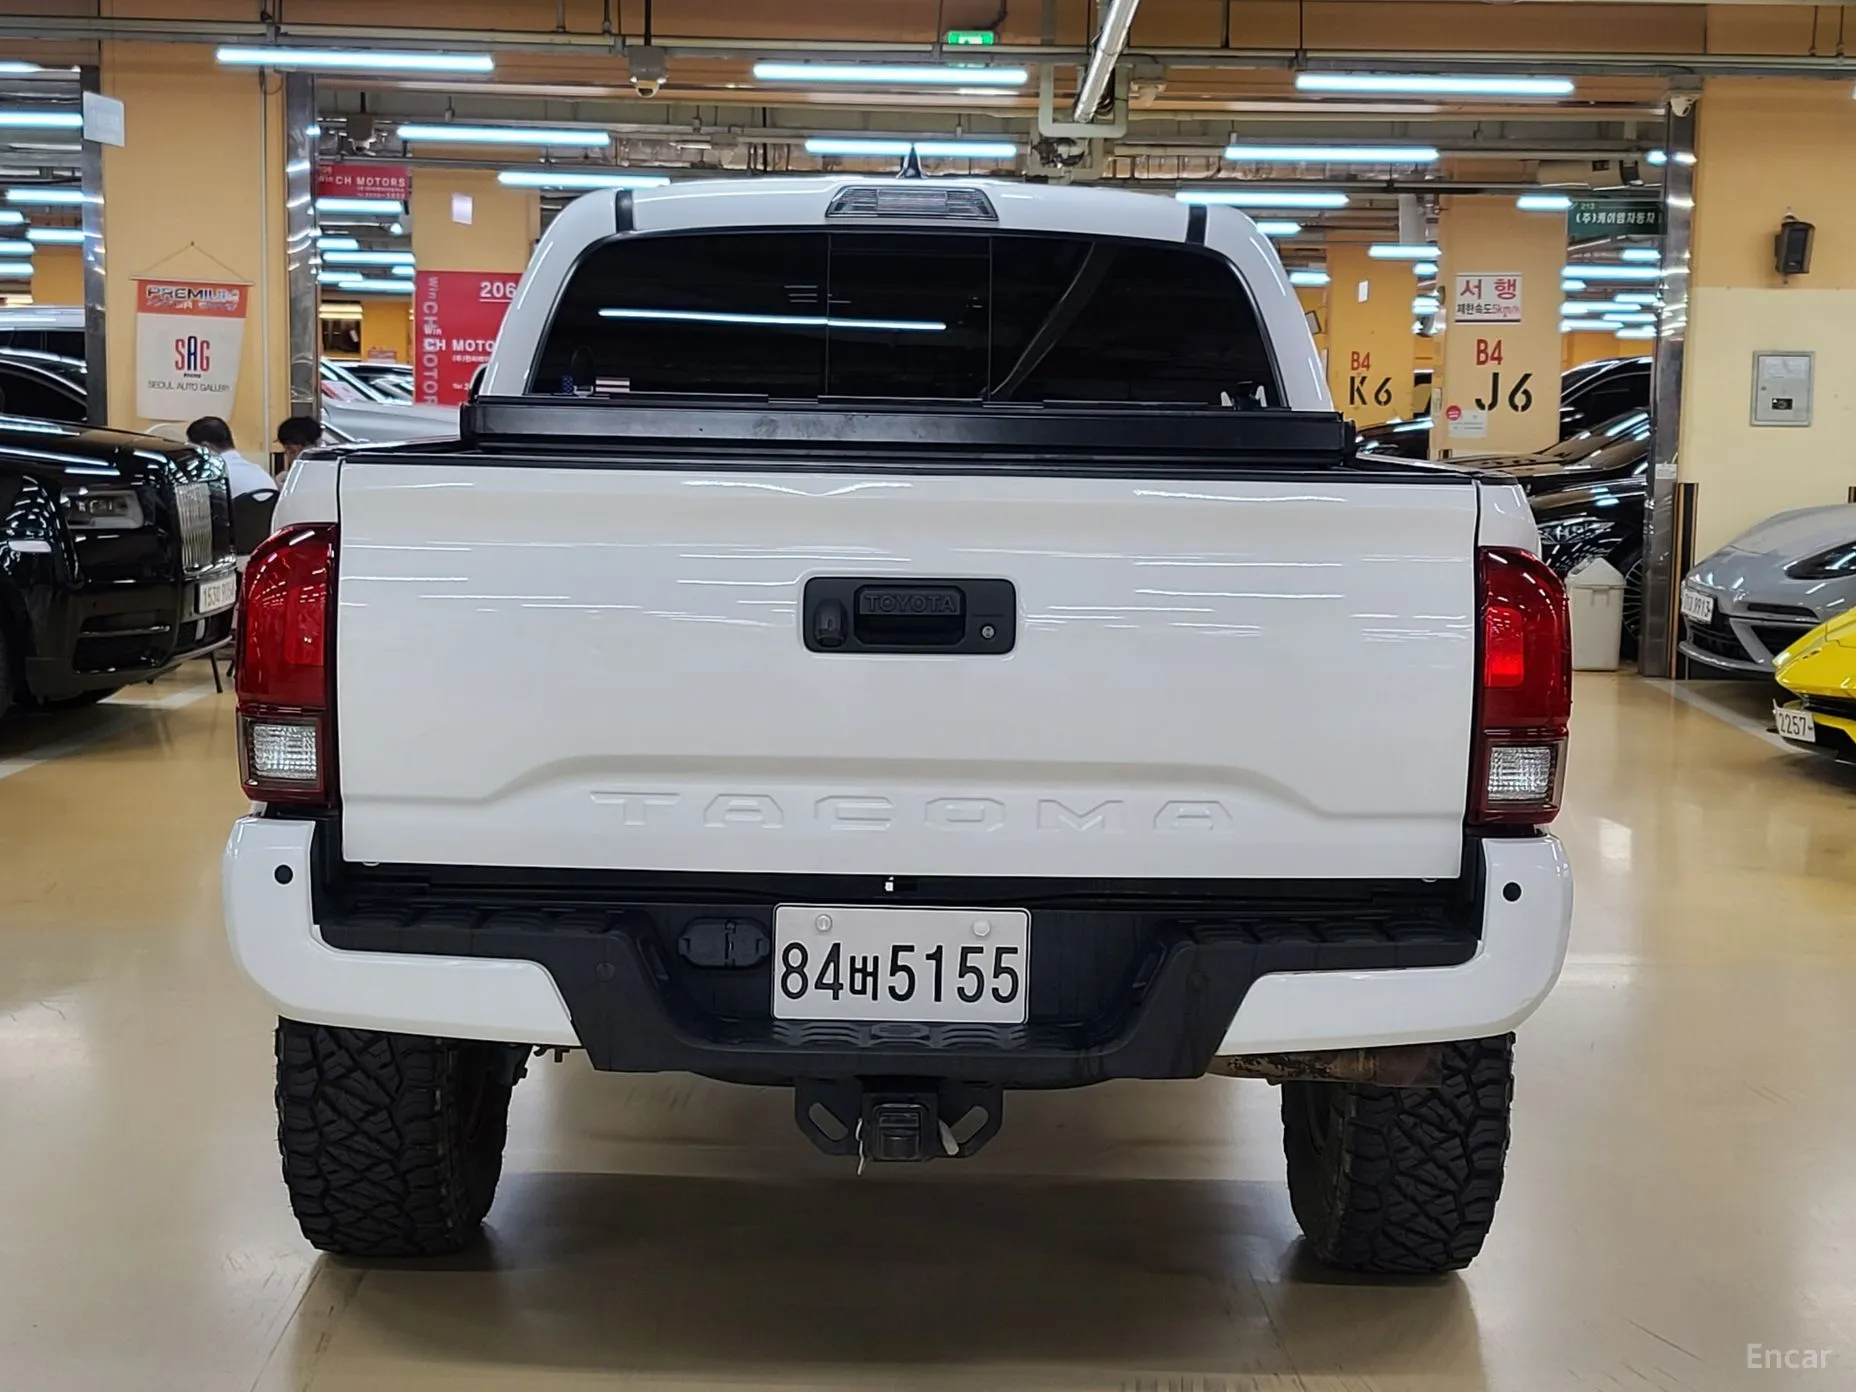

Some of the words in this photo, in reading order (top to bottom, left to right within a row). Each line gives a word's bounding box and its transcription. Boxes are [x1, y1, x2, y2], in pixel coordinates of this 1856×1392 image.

[356, 176, 406, 188] MOTORS
[1581, 202, 1596, 210] 213
[480, 281, 517, 298] 206
[175, 335, 211, 372] SAG
[1350, 351, 1371, 371] B4
[1475, 339, 1503, 365] B4
[147, 380, 174, 390] SEOUL
[176, 381, 198, 391] AUTO
[200, 383, 230, 393] GALLERY
[866, 594, 957, 613] TOYOTA
[1778, 711, 1807, 737] 2257
[590, 791, 1235, 834] TACOMA
[781, 942, 1019, 1004] 84버5155
